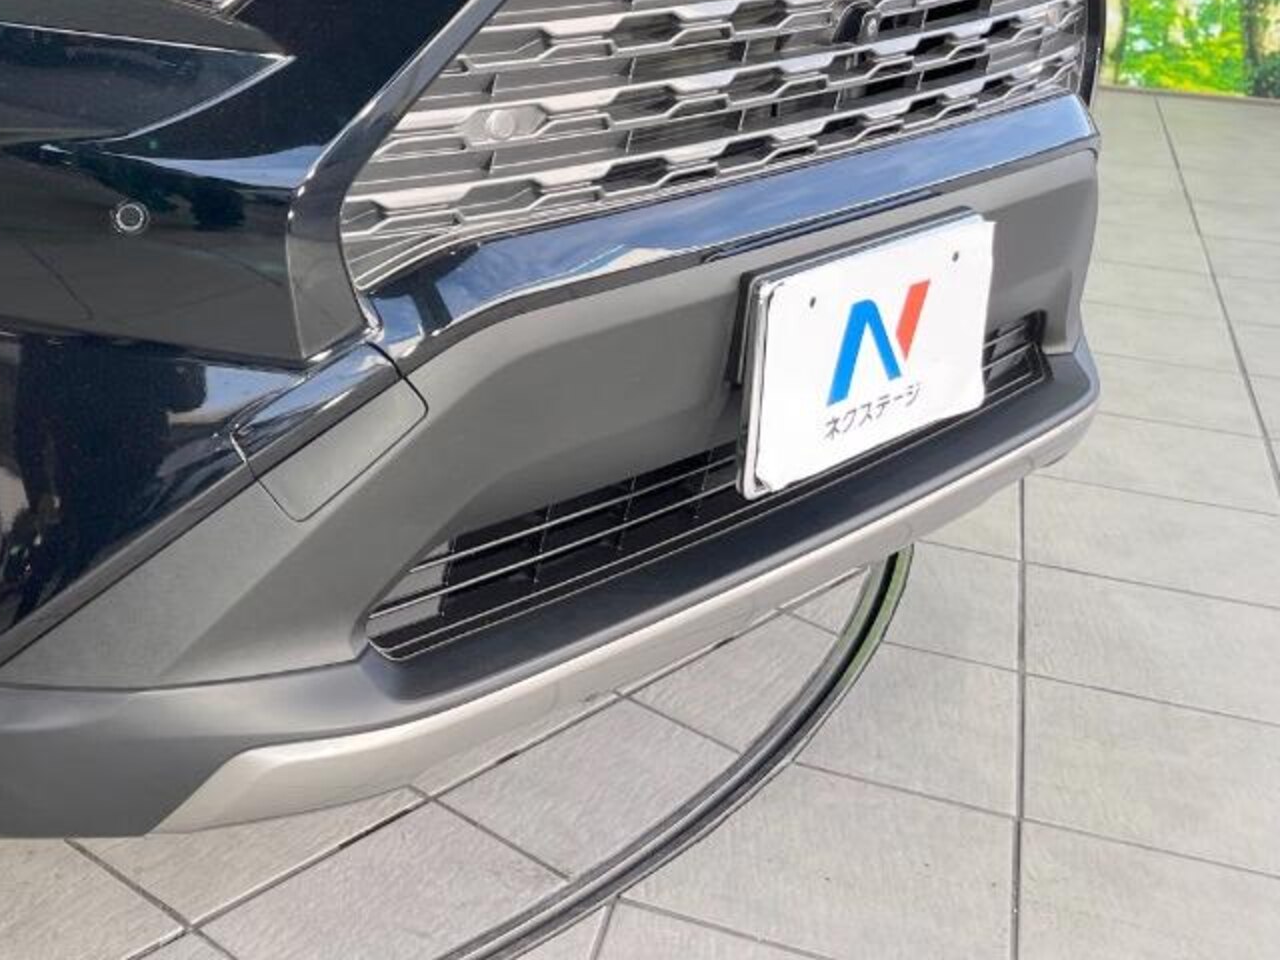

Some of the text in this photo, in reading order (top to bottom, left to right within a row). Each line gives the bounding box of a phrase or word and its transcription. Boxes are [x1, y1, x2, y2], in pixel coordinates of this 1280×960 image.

[824, 383, 921, 440] ネクステージ
